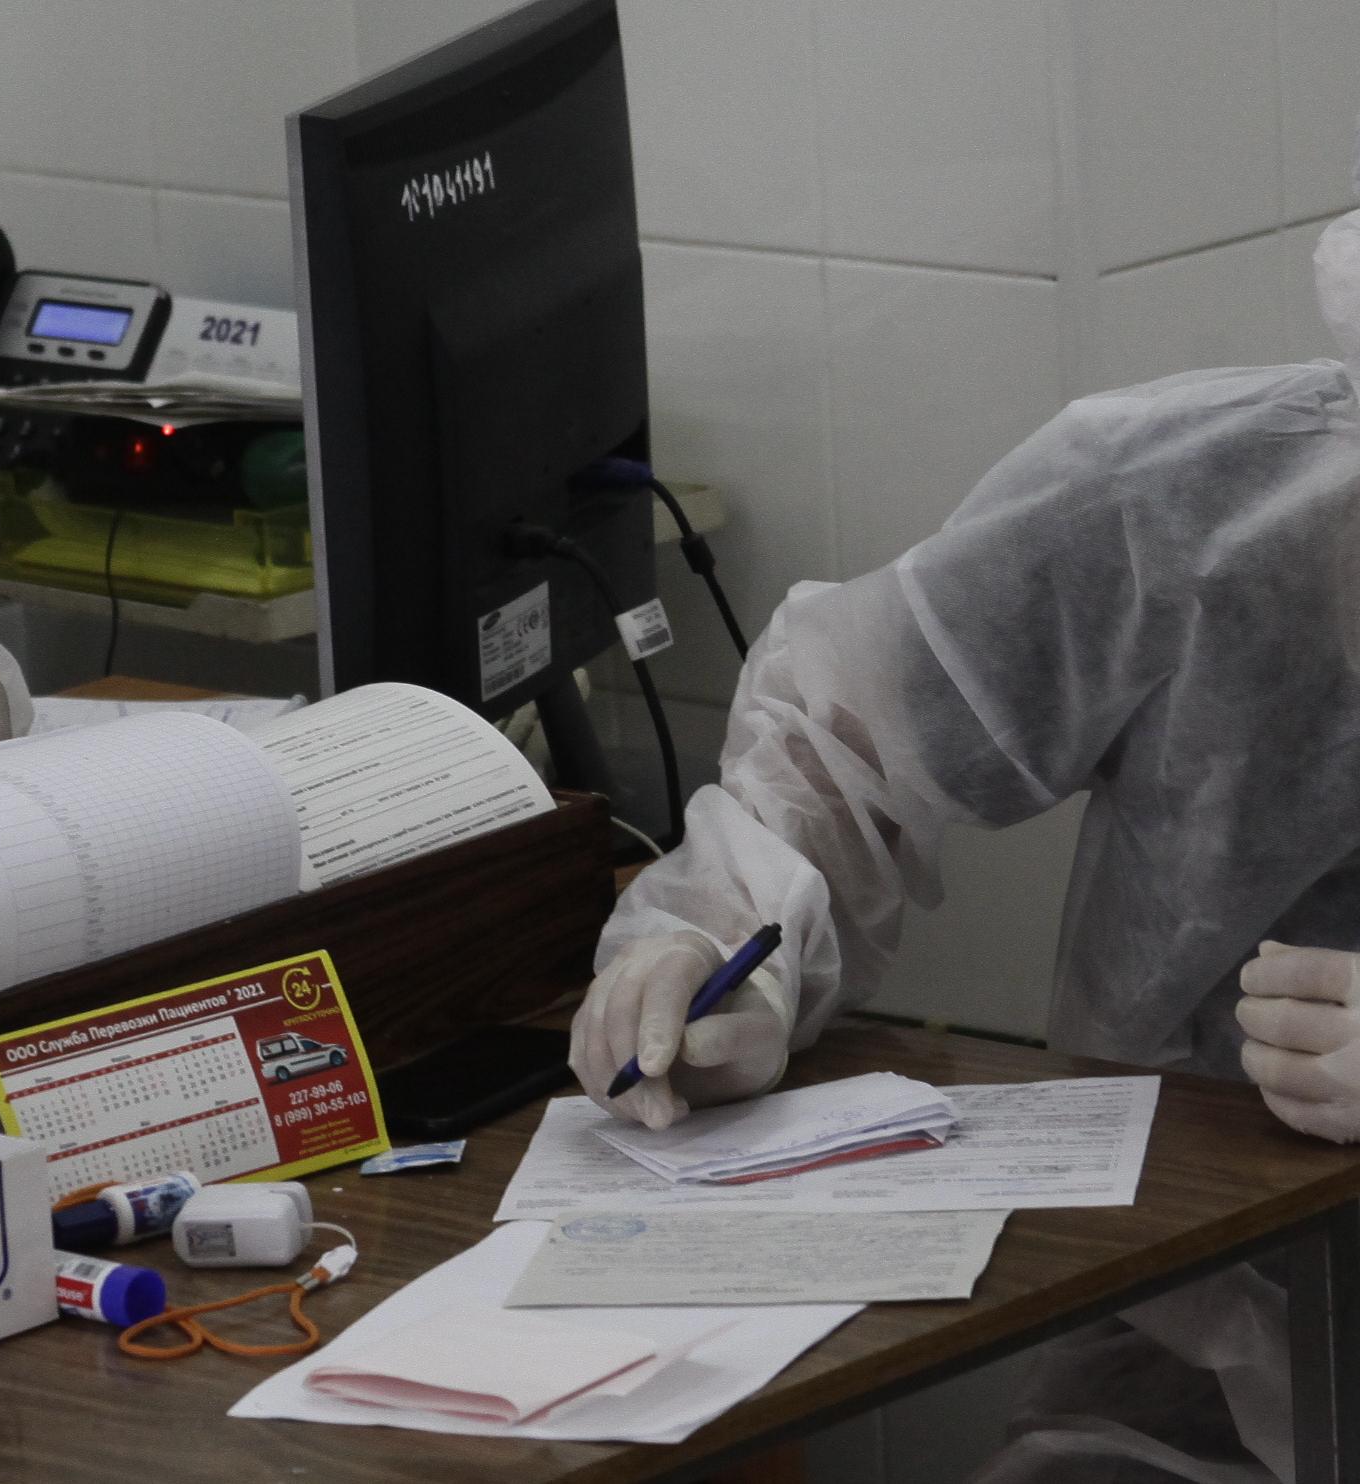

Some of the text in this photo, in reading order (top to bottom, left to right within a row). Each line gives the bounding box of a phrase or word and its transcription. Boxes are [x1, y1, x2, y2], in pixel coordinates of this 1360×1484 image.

[199, 314, 262, 347] 2021
[292, 979, 312, 998] 24
[6, 1043, 38, 1063] ООО
[39, 1031, 90, 1055] Служба
[89, 1014, 159, 1040] Перевозки
